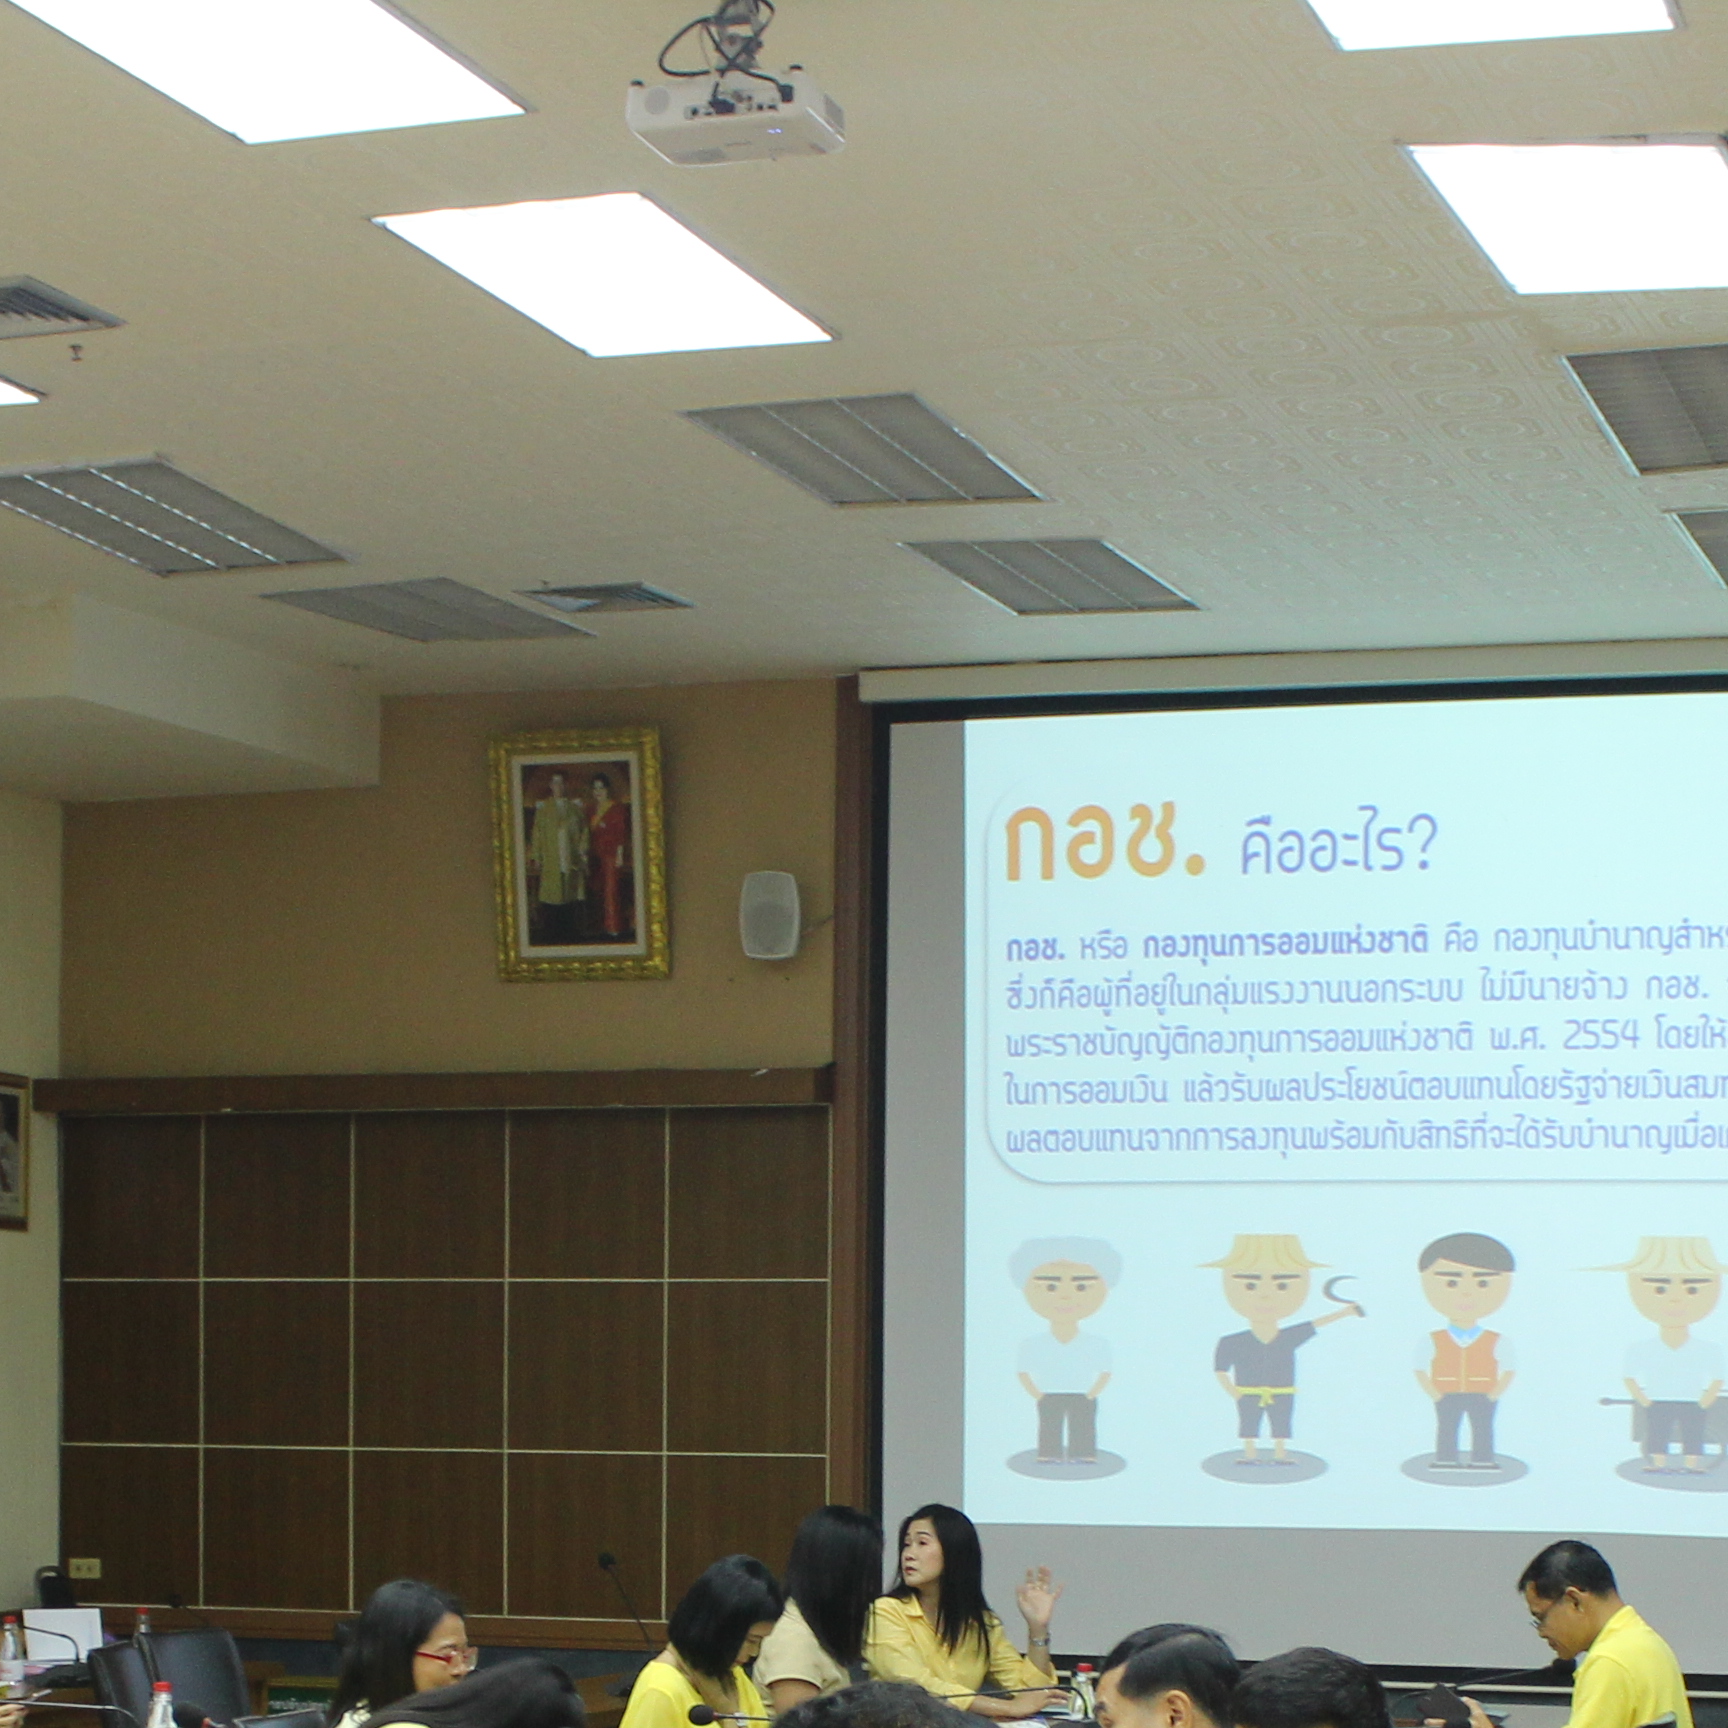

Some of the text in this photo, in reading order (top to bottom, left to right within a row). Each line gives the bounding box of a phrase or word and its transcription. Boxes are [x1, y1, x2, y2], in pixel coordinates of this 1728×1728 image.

[1004, 801, 1438, 882] กอช. คืออะไร?
[1007, 937, 1065, 961] กอช.
[1080, 928, 1128, 959] หรือ
[1446, 921, 1478, 952] คือ
[1481, 966, 1627, 1000] ไม่มีนายจ้าง
[1647, 975, 1709, 998] กอช.
[1491, 1026, 1546, 1050] พ.ศ.
[1564, 1019, 1640, 1049] 2554
[1005, 1071, 1168, 1104] ในการออมเงิน
